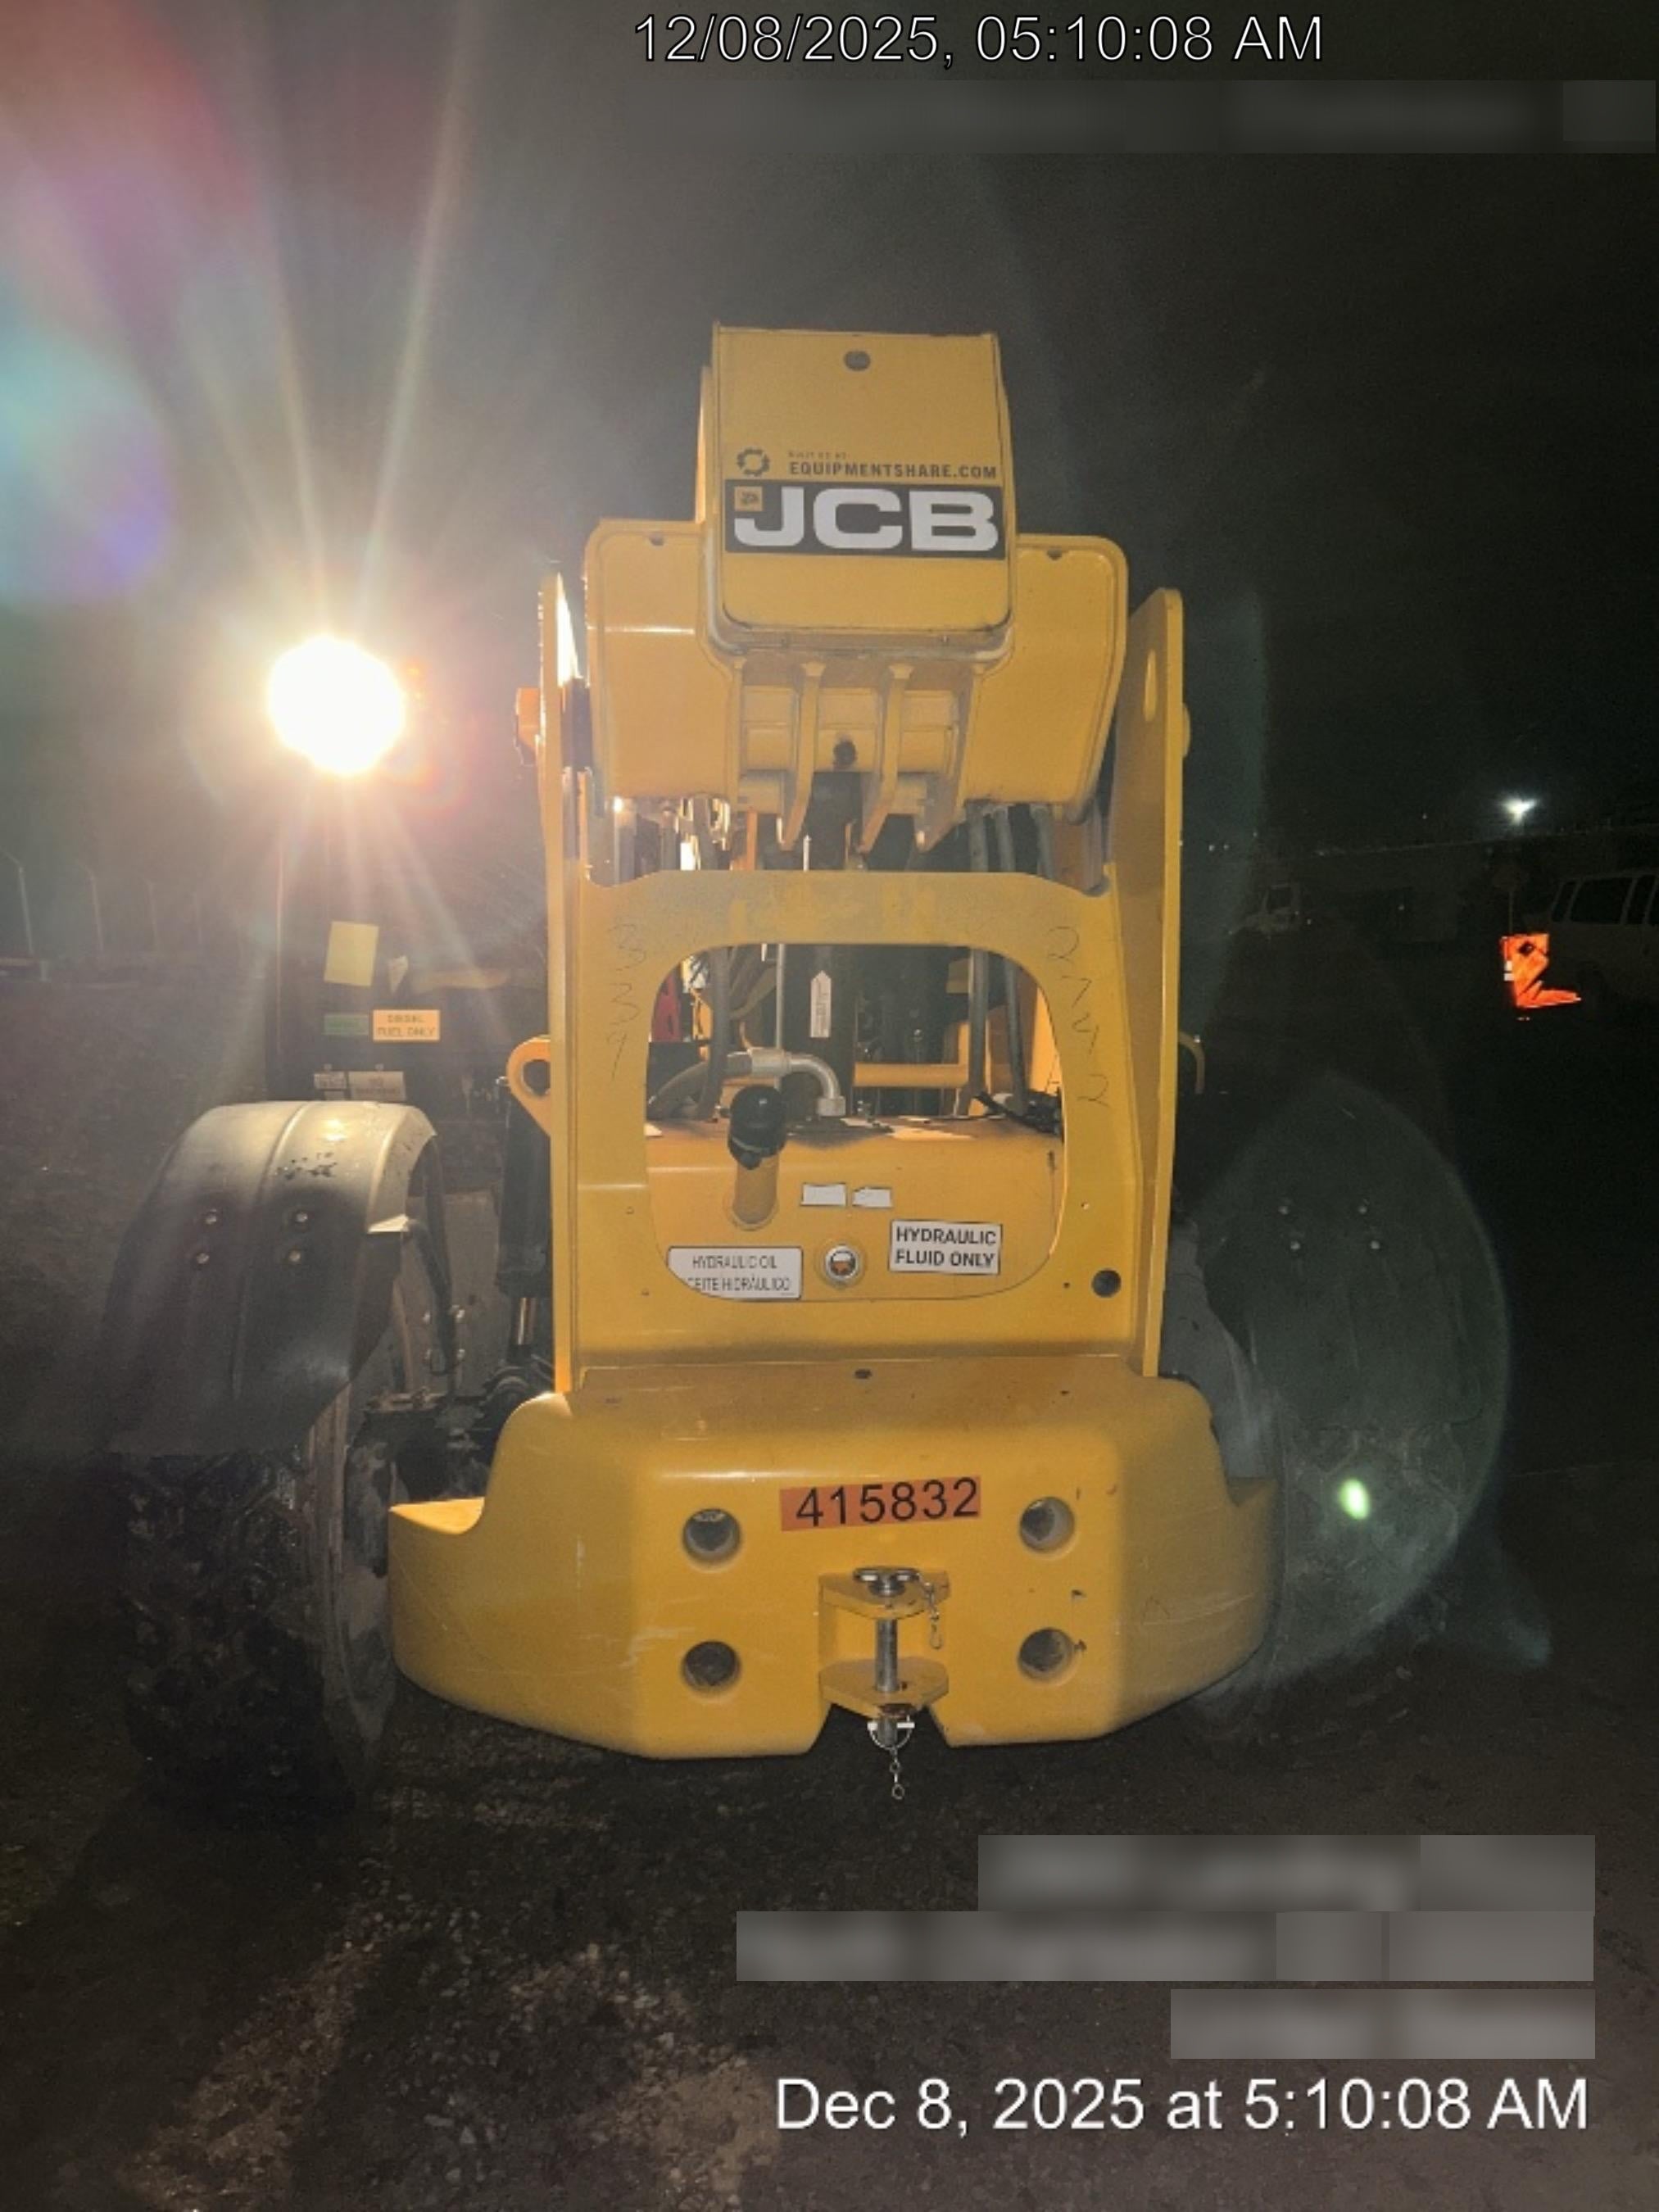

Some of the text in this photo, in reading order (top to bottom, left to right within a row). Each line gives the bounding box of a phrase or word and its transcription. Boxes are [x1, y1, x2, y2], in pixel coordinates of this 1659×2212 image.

[789, 460, 997, 478] EQUIPMENTSHARE.COM
[734, 486, 999, 552] JCB
[896, 1226, 996, 1245] HYDRAULIC
[692, 1255, 757, 1269] HYDRAULIC
[895, 1249, 995, 1268] FLUID ONLY
[796, 1477, 979, 1526] 415832
